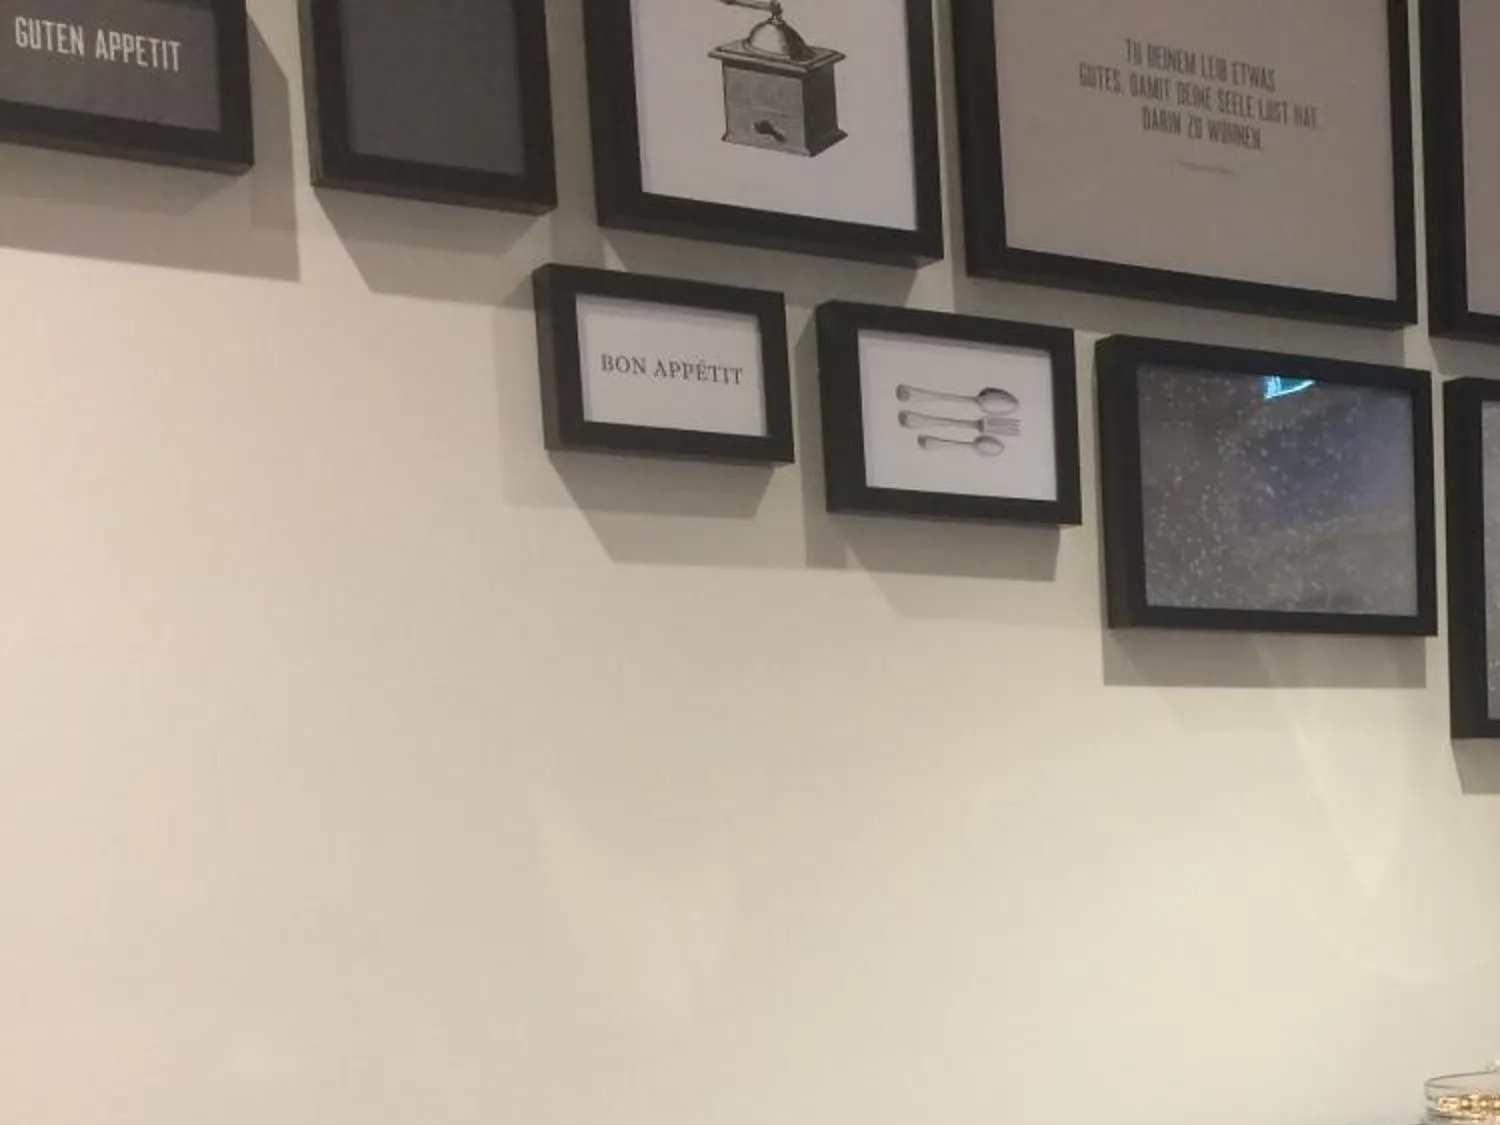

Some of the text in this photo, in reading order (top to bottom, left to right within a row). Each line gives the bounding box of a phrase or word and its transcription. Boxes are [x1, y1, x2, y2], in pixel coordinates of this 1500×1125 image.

[15, 16, 182, 73] GUTEN APPETIT
[1129, 72, 1170, 101] DAMIT
[1232, 61, 1276, 92] ETWAS
[601, 353, 743, 385] BON APPÉTIT
